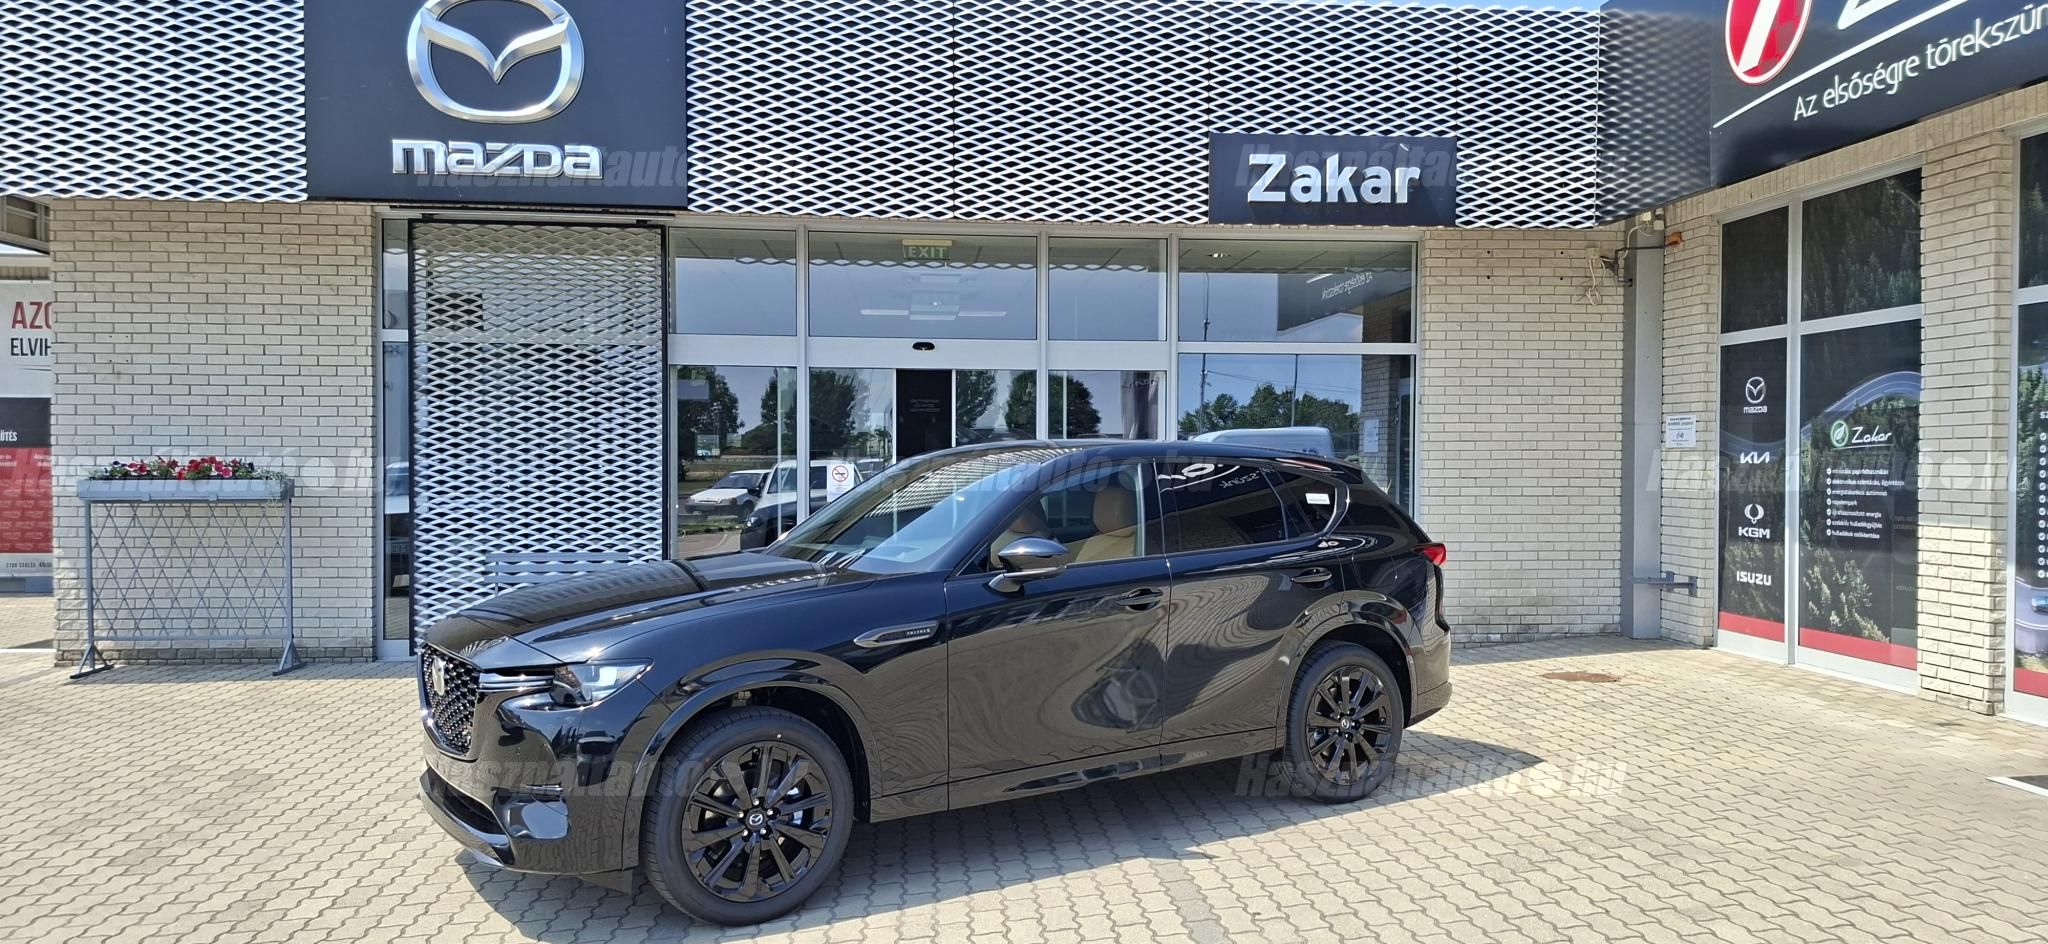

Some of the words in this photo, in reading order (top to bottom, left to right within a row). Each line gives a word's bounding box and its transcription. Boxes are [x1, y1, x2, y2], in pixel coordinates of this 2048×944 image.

[1794, 95, 1818, 121] Az
[1823, 56, 1920, 109] elsőségre
[392, 139, 604, 179] mazda
[1247, 153, 1421, 203] Zakar
[908, 246, 947, 259] EXIT
[1743, 405, 1768, 414] mazda
[1851, 424, 1892, 443] Zakar
[1738, 526, 1770, 539] KGM
[1736, 570, 1772, 585] ISUZU
